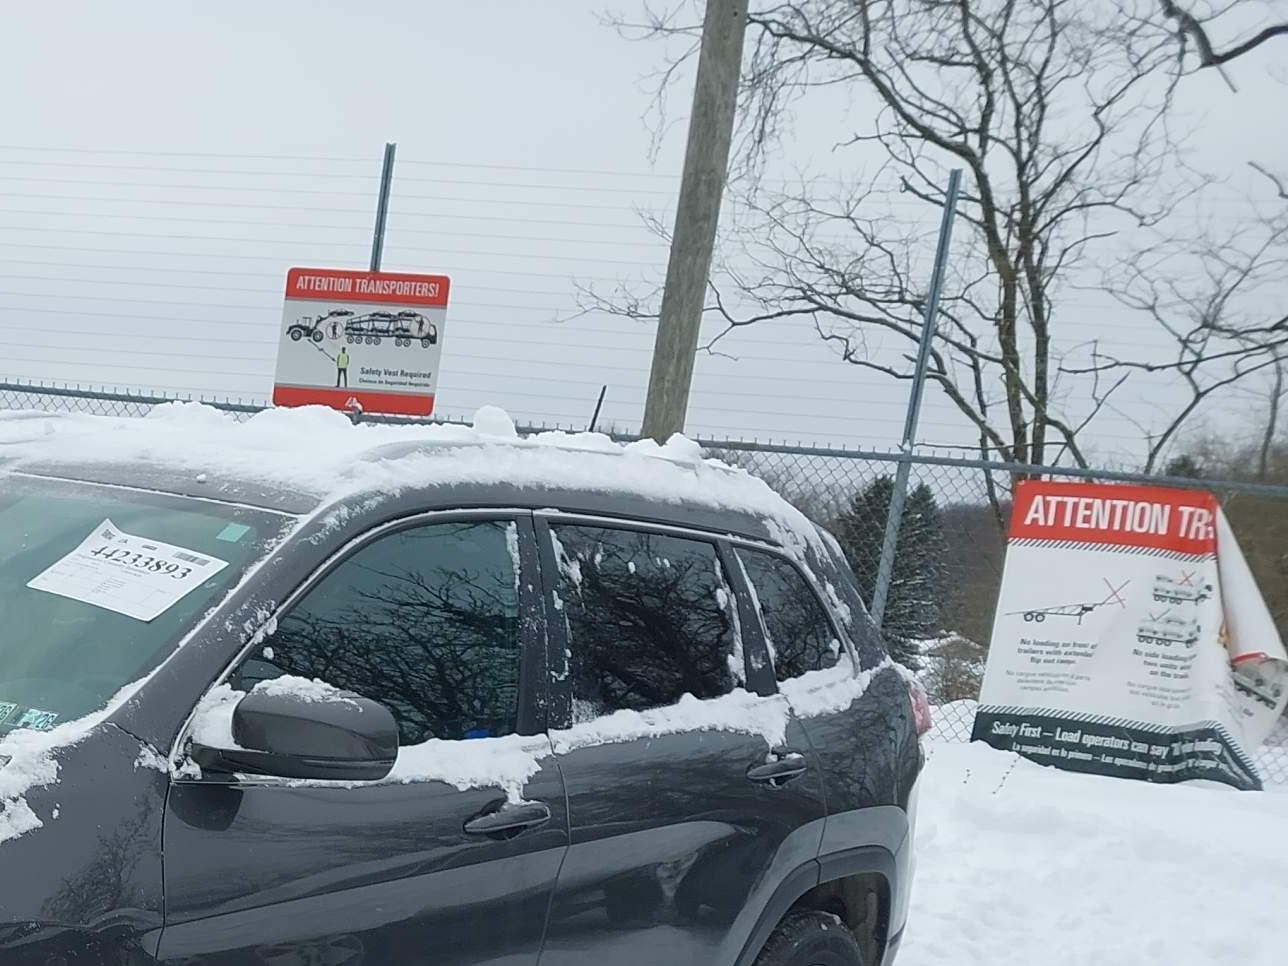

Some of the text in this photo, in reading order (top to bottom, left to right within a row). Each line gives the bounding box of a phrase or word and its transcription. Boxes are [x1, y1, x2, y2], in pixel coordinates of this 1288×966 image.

[296, 275, 440, 297] ATTENTION TRANSPORTERS!
[360, 367, 432, 379] Safety Vest Required
[1024, 494, 1171, 536] ATTENTION
[90, 545, 193, 580] 44233893
[992, 721, 1019, 738] Safety
[1019, 722, 1042, 738] First
[1055, 727, 1081, 743] Load
[1082, 733, 1130, 750] operators
[1131, 741, 1149, 753] can
[1149, 744, 1170, 759] say
